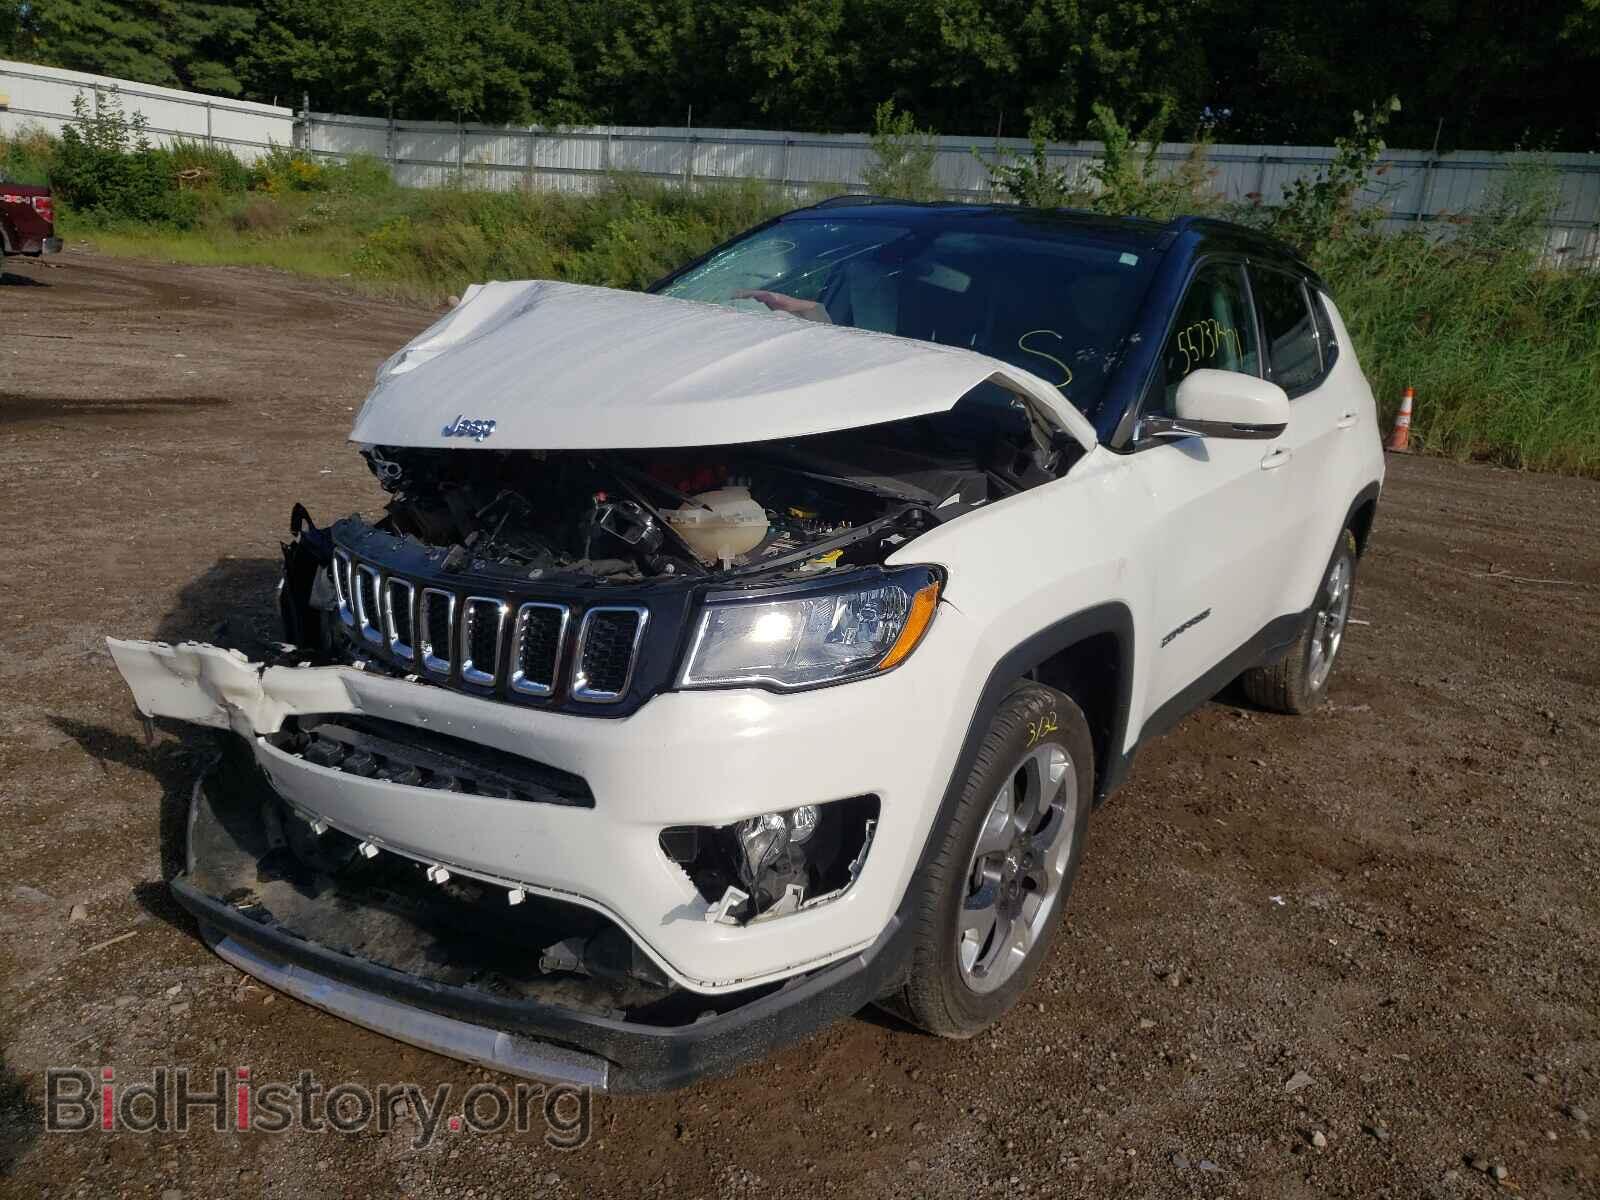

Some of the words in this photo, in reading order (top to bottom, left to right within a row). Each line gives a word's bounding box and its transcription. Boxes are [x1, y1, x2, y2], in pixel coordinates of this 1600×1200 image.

[1018, 328, 1073, 388] S
[441, 414, 497, 442] Jeep
[1026, 711, 1058, 748] 3/32
